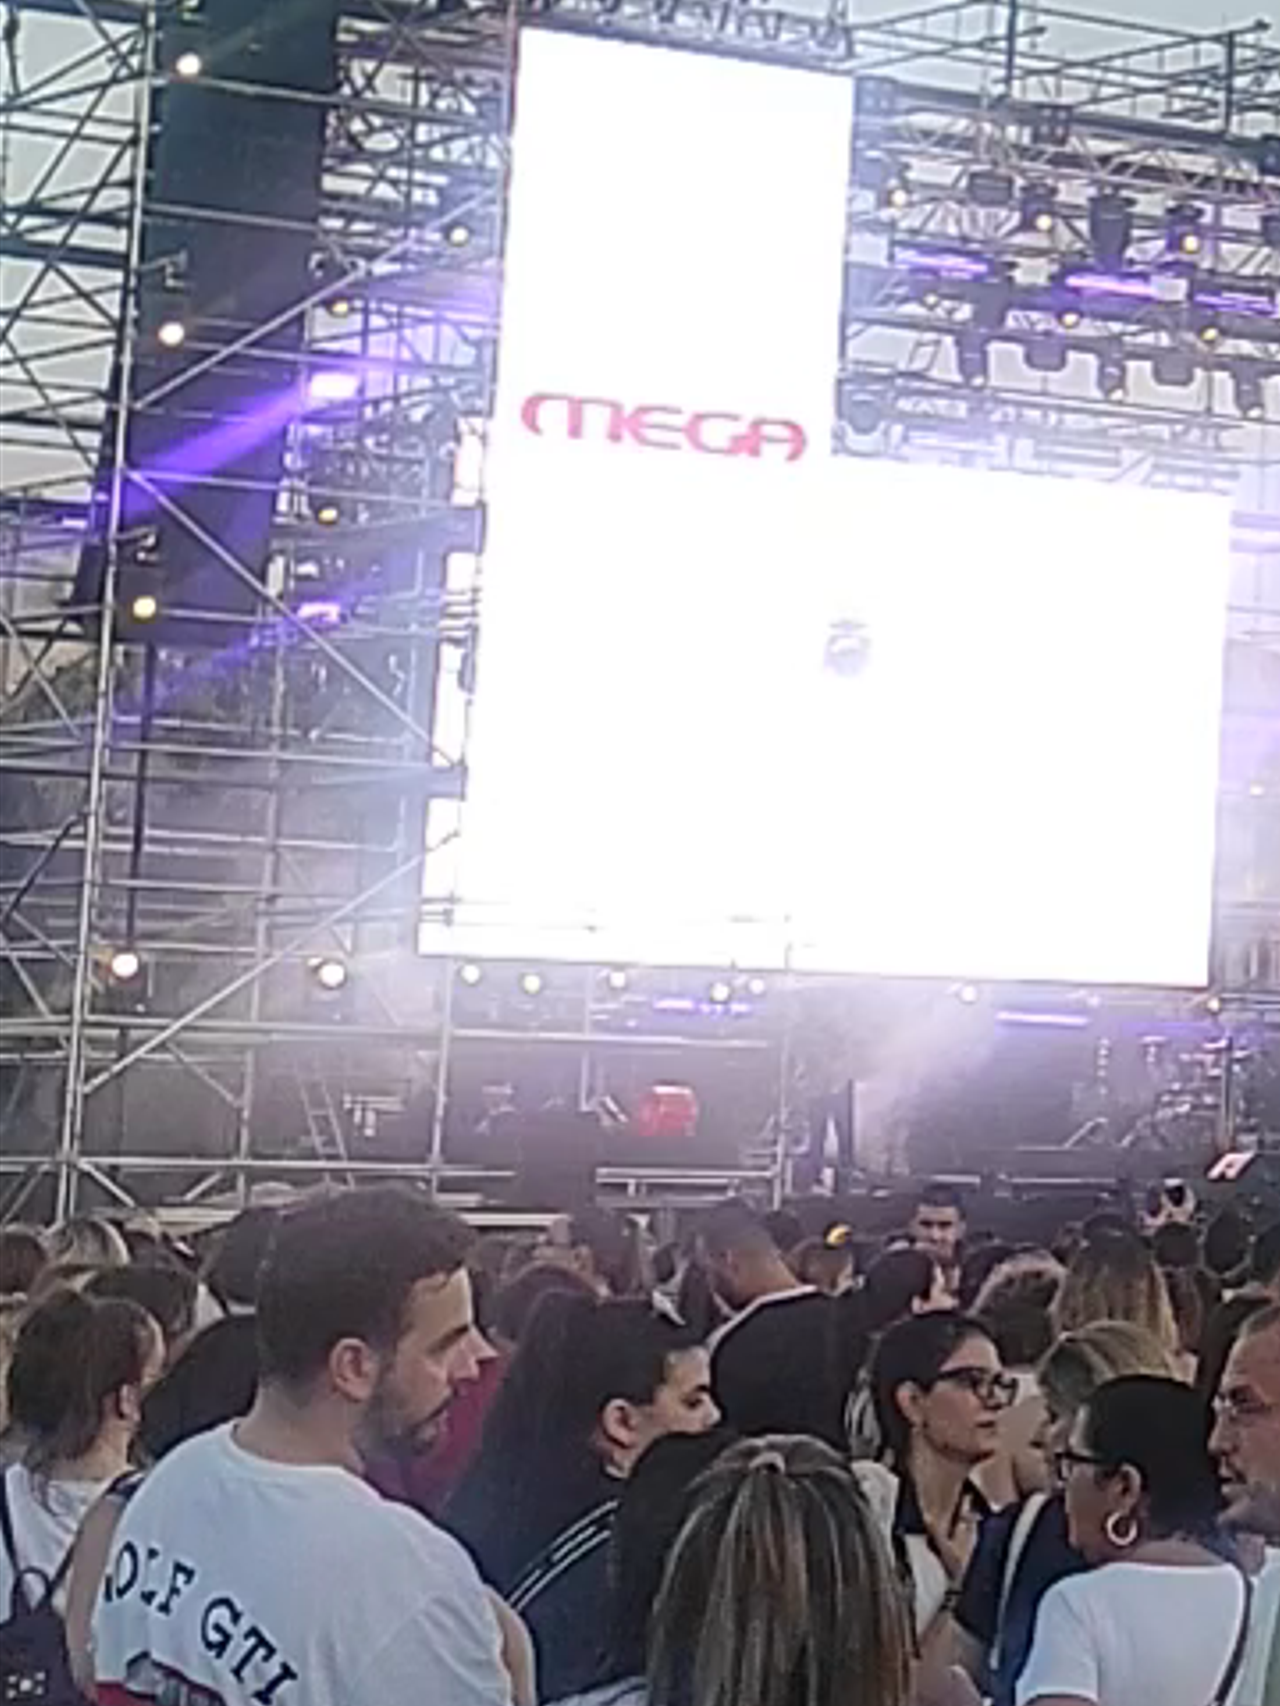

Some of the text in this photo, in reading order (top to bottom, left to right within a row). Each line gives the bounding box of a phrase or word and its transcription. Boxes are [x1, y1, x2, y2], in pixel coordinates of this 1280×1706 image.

[520, 391, 808, 462] MEGA
[104, 1540, 298, 1706] OLF GTI
